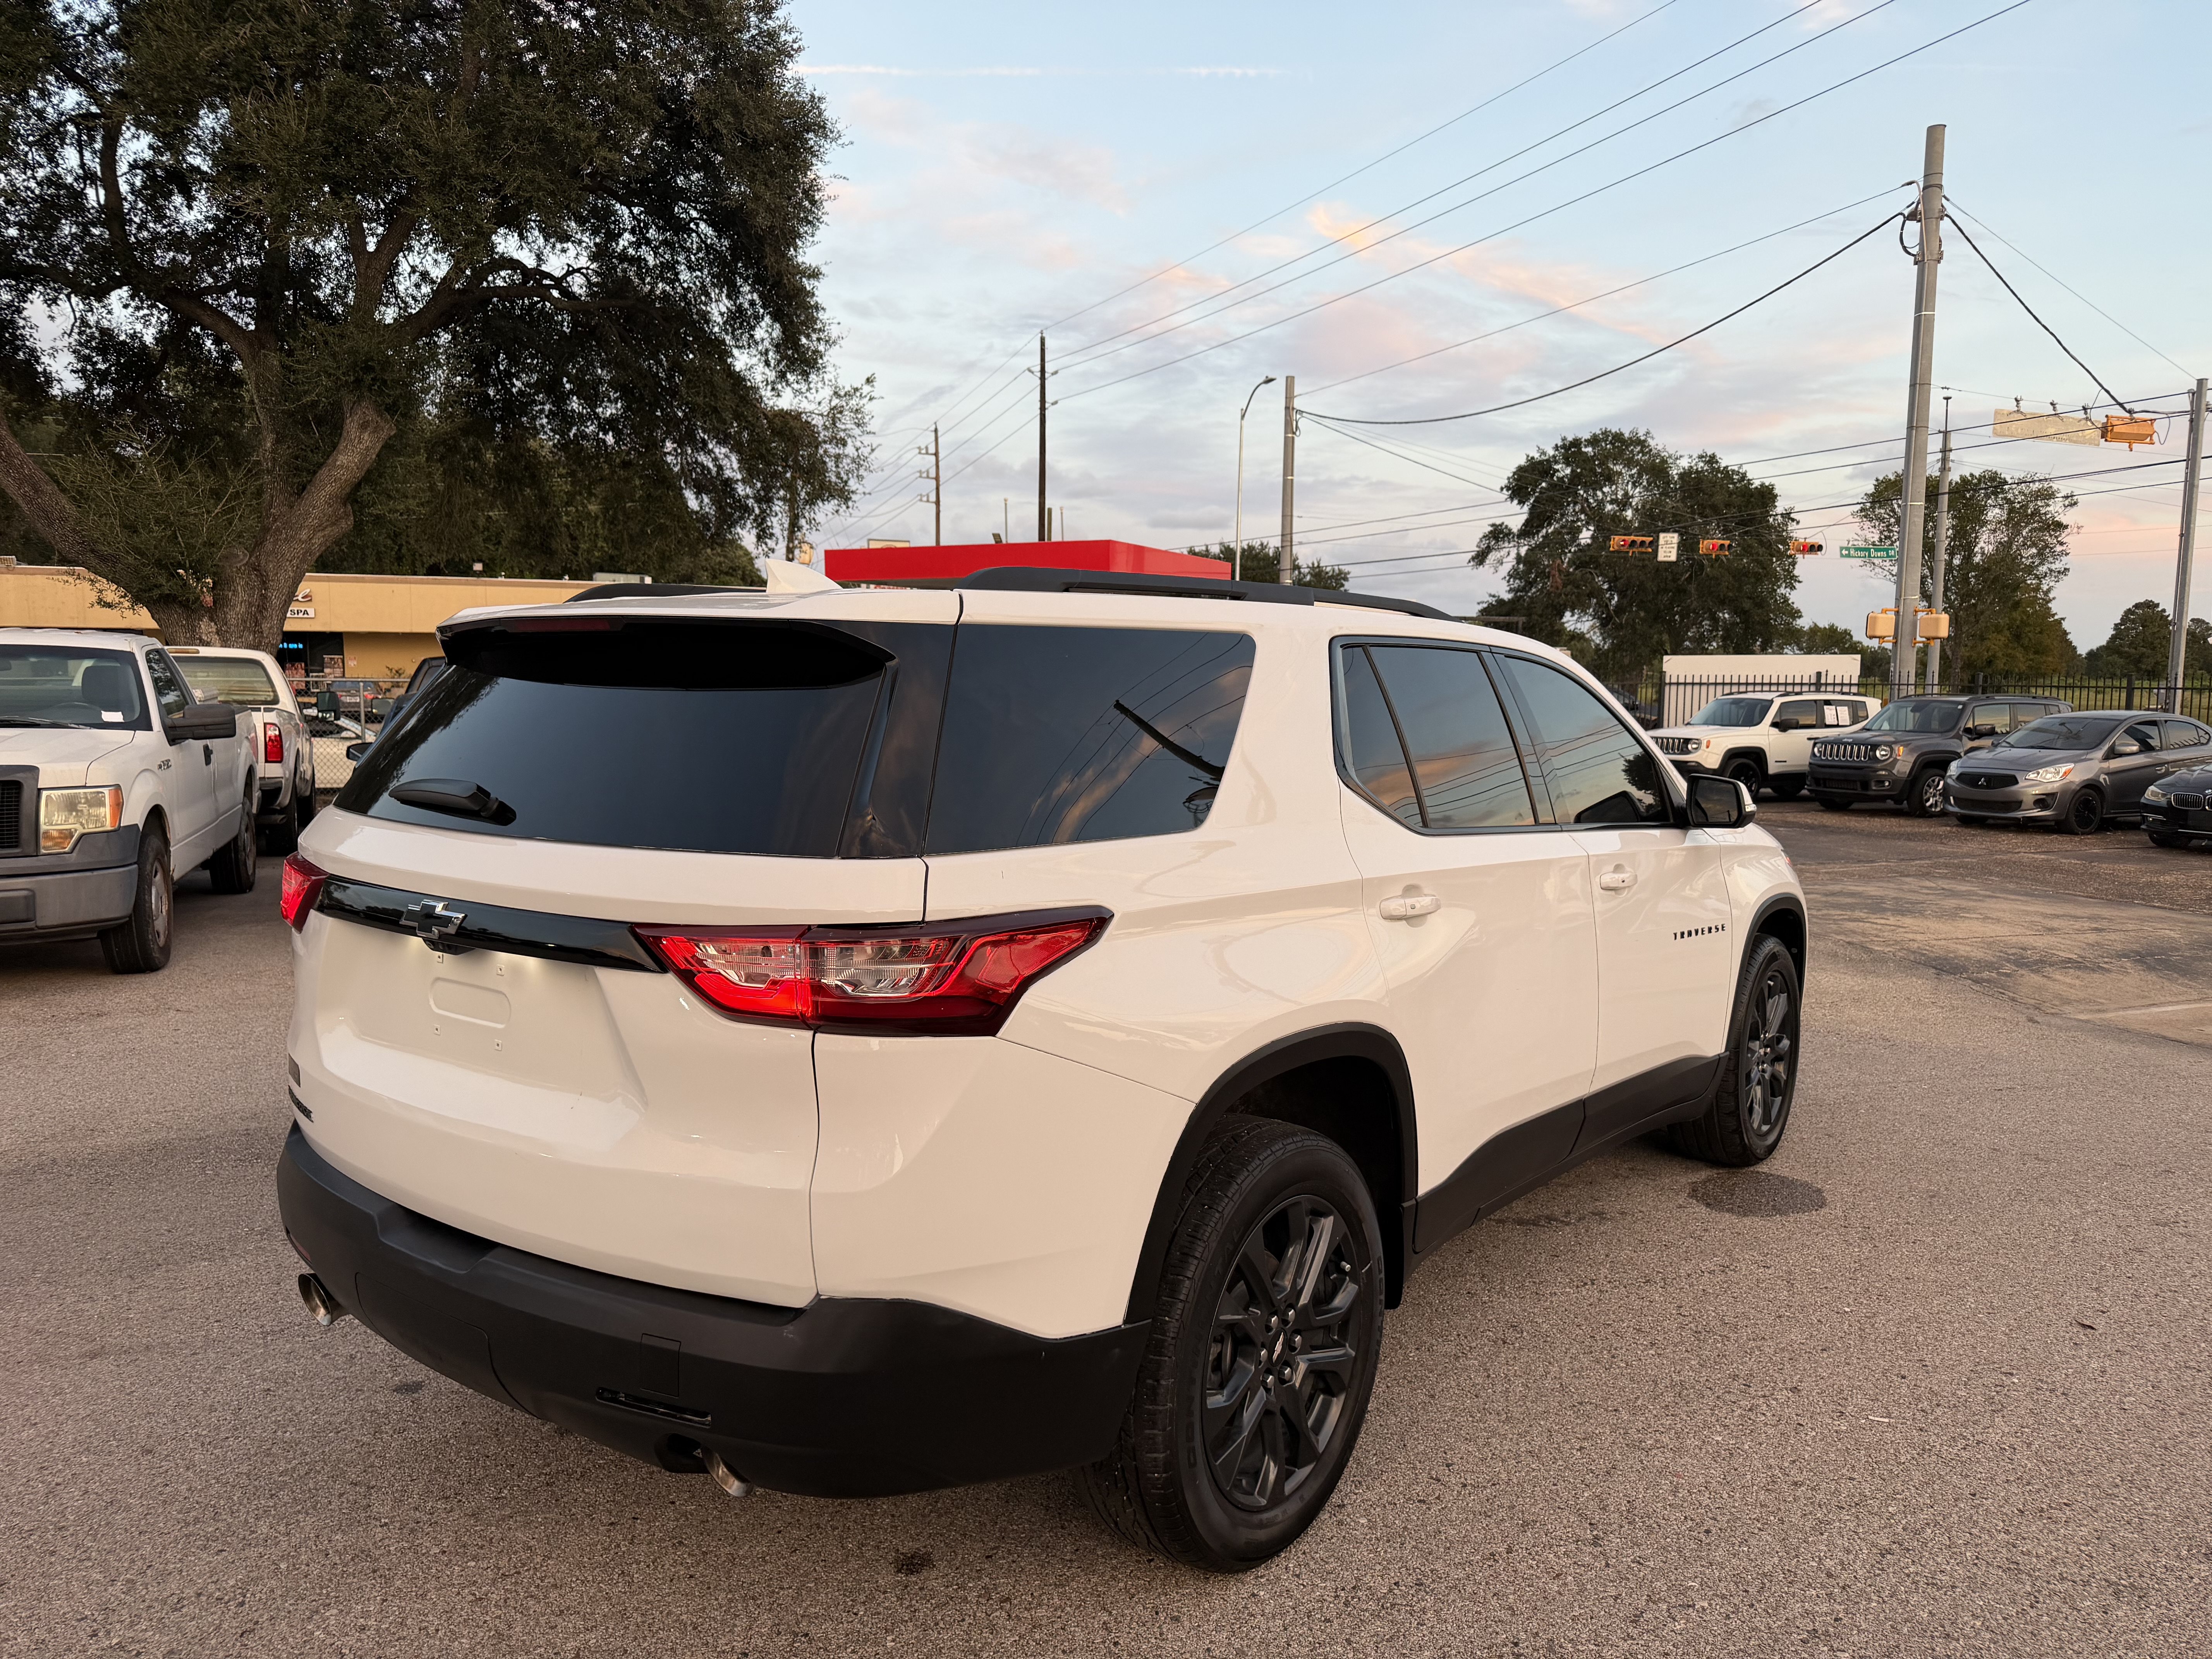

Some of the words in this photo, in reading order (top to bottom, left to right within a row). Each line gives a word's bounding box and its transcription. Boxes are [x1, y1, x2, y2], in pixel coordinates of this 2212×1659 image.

[1850, 548, 1868, 558] Hickory
[1871, 549, 1887, 557] Downs
[1673, 923, 1726, 940] TRAVERSE
